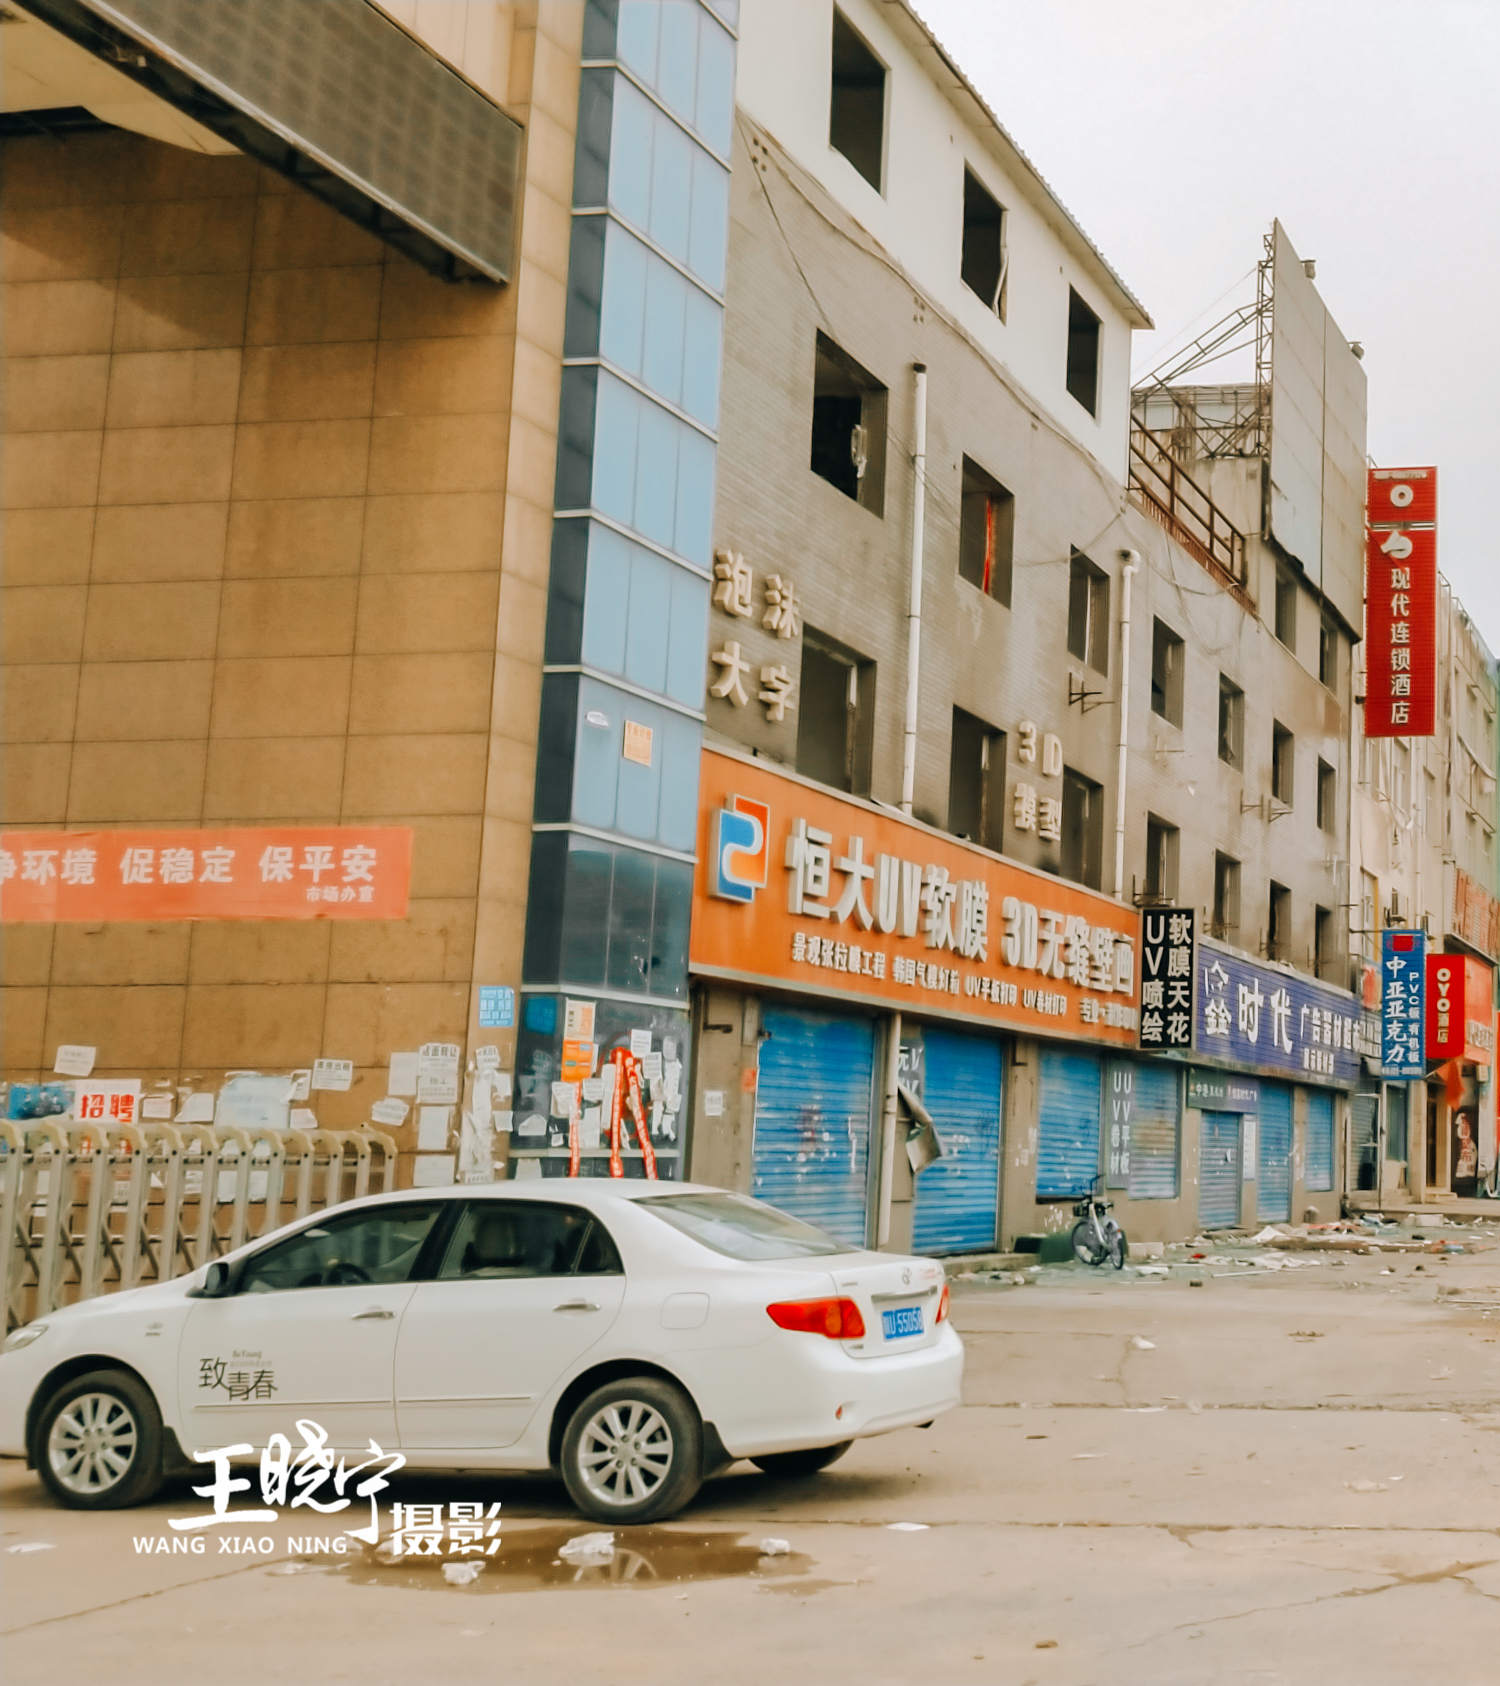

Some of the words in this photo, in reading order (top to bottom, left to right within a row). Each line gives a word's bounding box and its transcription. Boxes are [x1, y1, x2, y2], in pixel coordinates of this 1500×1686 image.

[713, 549, 799, 640] 泡沫
[711, 641, 794, 722] 大字
[1390, 568, 1410, 725] 现代连锁酒店
[1018, 720, 1064, 777] 3D
[1013, 783, 1062, 842] 模型
[120, 846, 236, 884] 促稳定
[259, 845, 378, 883] 保平安
[306, 885, 375, 903] 市场办宣
[784, 817, 989, 963] 恒大UV软膜
[1002, 896, 1135, 997] 3D无缝壁画
[791, 931, 886, 980] 景观张拉膜工程
[964, 975, 1017, 1008] UV平板打印
[1022, 990, 1067, 1016] UV卷材打印
[1141, 914, 1165, 1044] UV喷绘
[1167, 913, 1192, 1044] 软膜天花
[1384, 955, 1408, 1064] 中亚亚克力
[1437, 968, 1451, 1044] OYO酒店
[1408, 1022, 1420, 1063] 有机板
[80, 1094, 135, 1123] 招聘
[198, 1357, 279, 1402] 致青春
